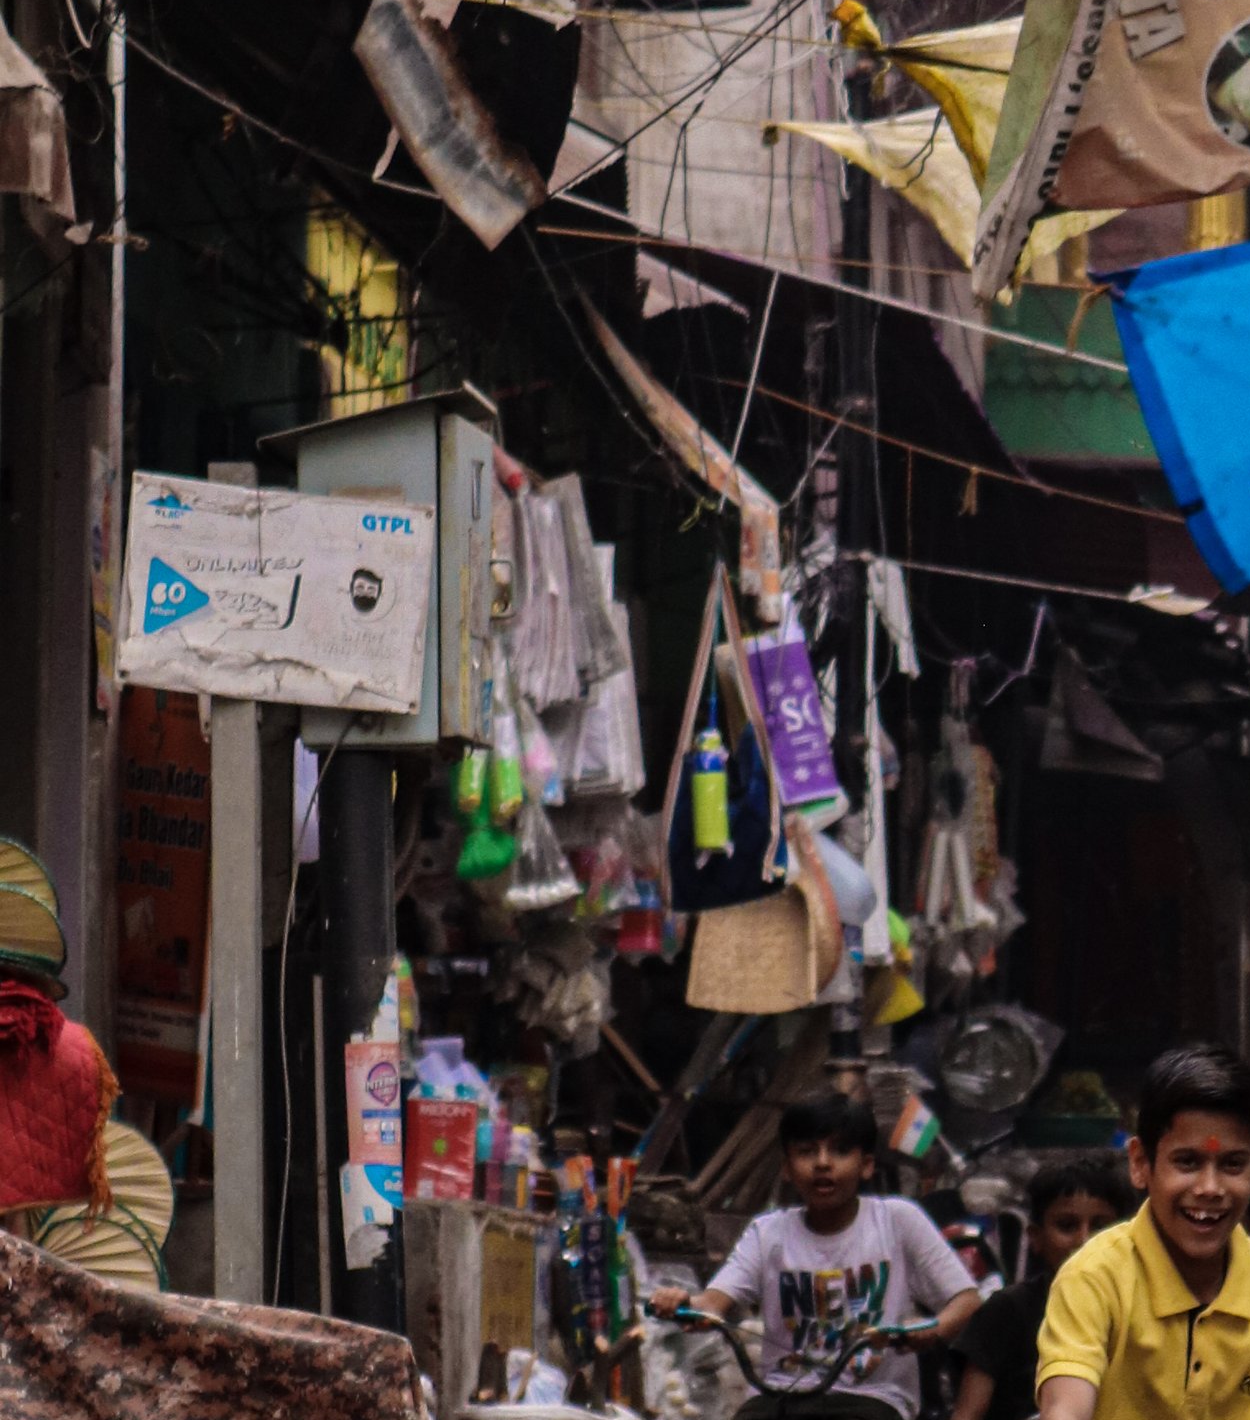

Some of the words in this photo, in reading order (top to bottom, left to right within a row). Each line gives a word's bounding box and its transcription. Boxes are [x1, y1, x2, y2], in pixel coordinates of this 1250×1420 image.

[361, 511, 415, 536] GTPL
[150, 581, 187, 606] 60
[779, 1260, 889, 1325] NEW
